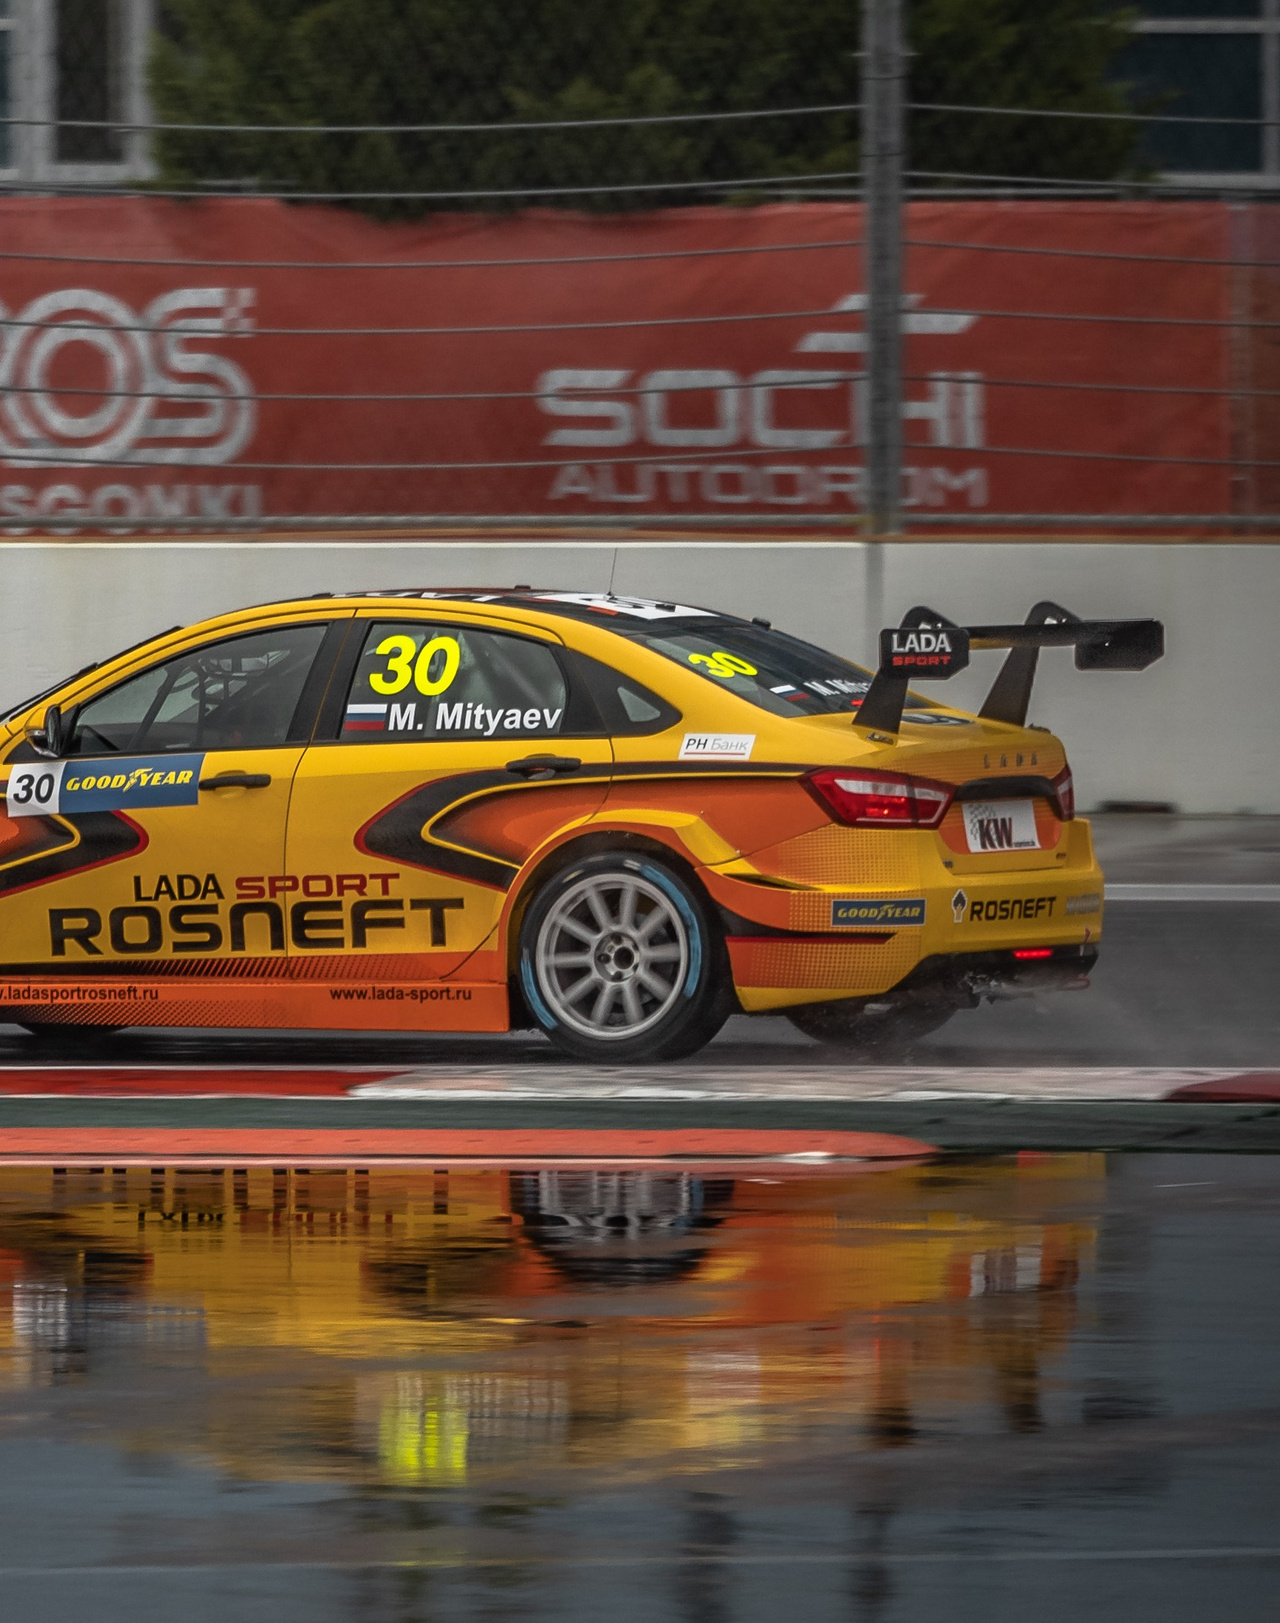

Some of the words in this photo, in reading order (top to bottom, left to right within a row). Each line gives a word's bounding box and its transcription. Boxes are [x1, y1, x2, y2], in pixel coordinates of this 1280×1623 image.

[536, 369, 985, 449] SOCHI
[891, 633, 952, 653] LADA
[369, 635, 460, 696] 30
[688, 652, 758, 678] 30
[892, 655, 951, 666] SPORT
[388, 703, 424, 731] M.
[435, 703, 562, 736] Mityaev
[711, 738, 748, 751] Банк
[13, 773, 55, 804] 30
[66, 767, 193, 792] GOODYEAR
[978, 817, 1012, 850] KW
[134, 874, 225, 901] LADA
[236, 873, 400, 899] SPORT
[837, 904, 921, 920] GOODYEAR
[970, 896, 1057, 921] ROSNEFT
[49, 898, 465, 957] ROSNEFT
[330, 986, 472, 1003] www.lada-sport.ru
